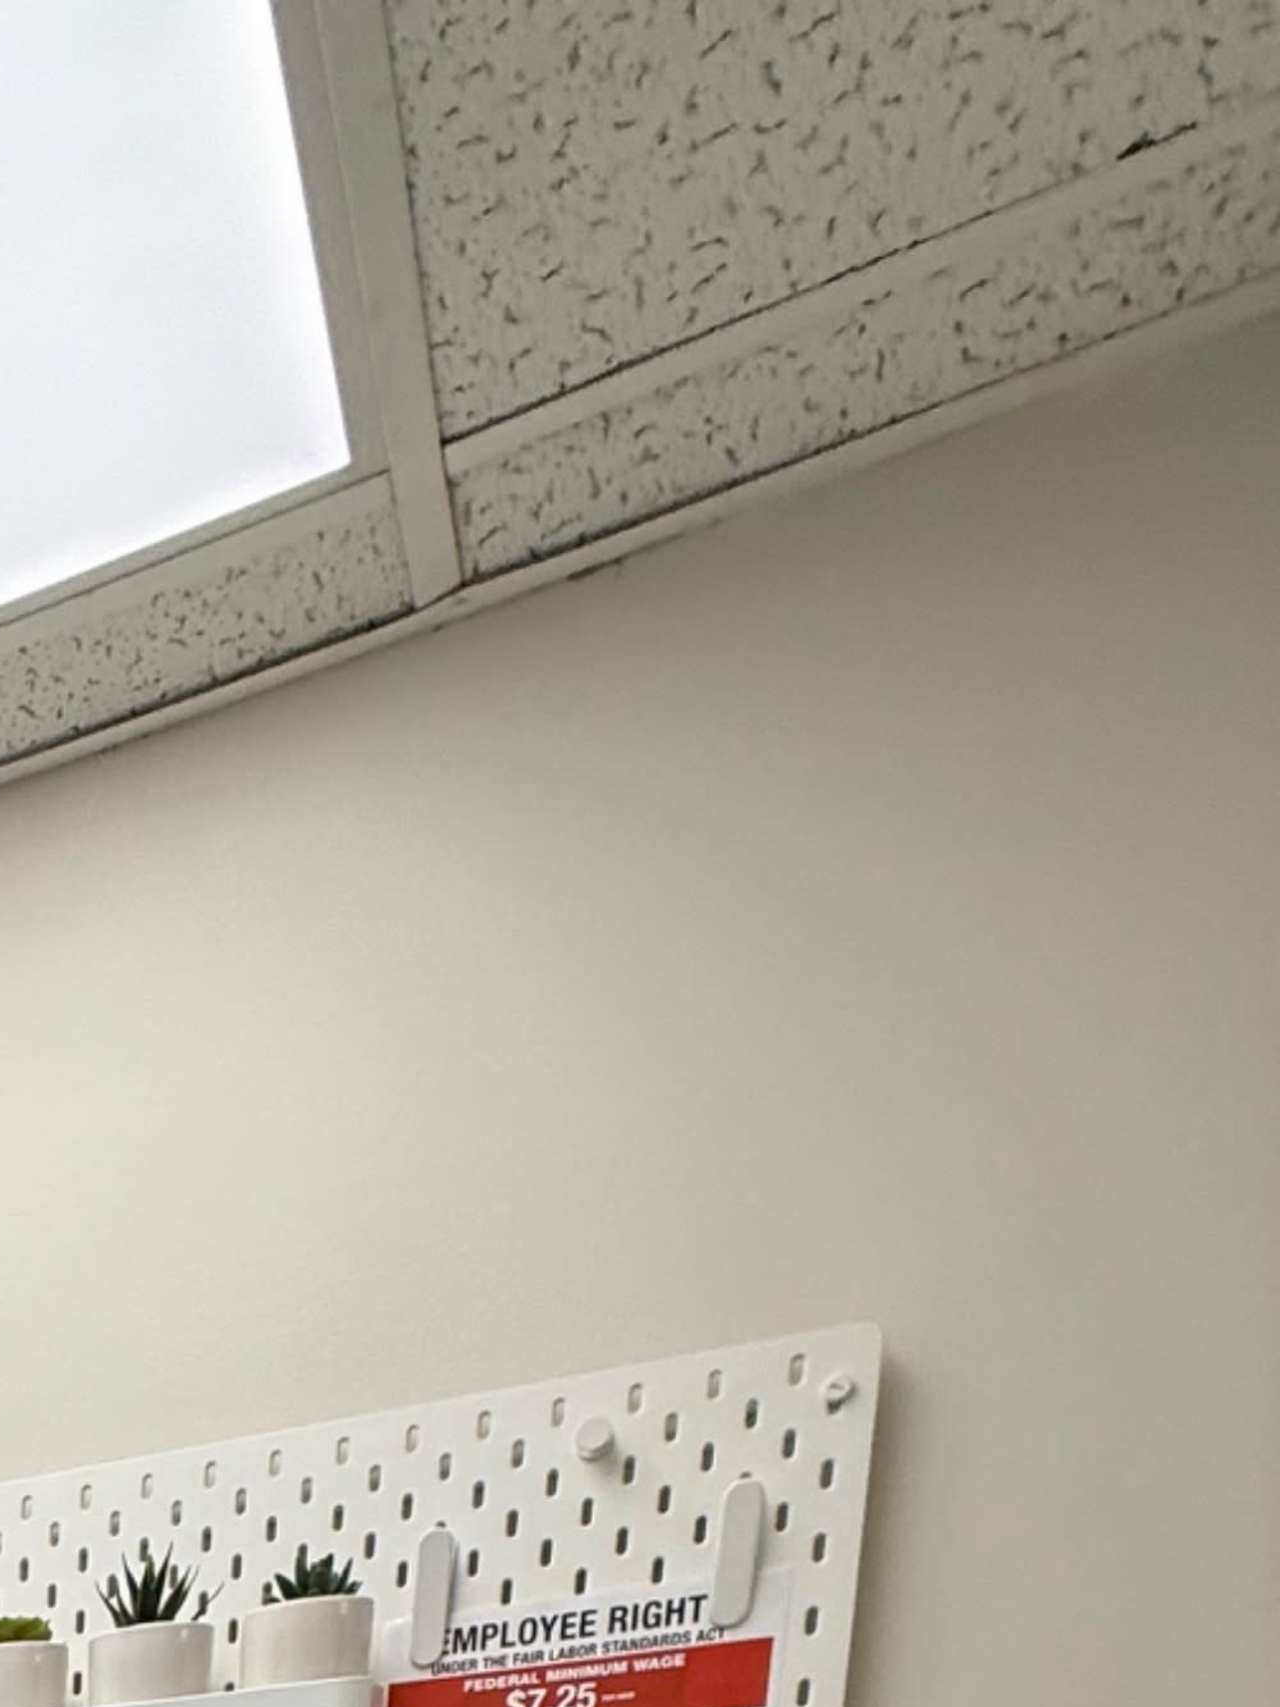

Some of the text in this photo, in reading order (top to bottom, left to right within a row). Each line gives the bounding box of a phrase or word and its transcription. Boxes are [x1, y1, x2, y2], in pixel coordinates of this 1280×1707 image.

[431, 1628, 726, 1676] UNDER THE FAIR LABOR STANDARDS ACT
[463, 1653, 687, 1693] FEDERAL MINIMUM WAGE
